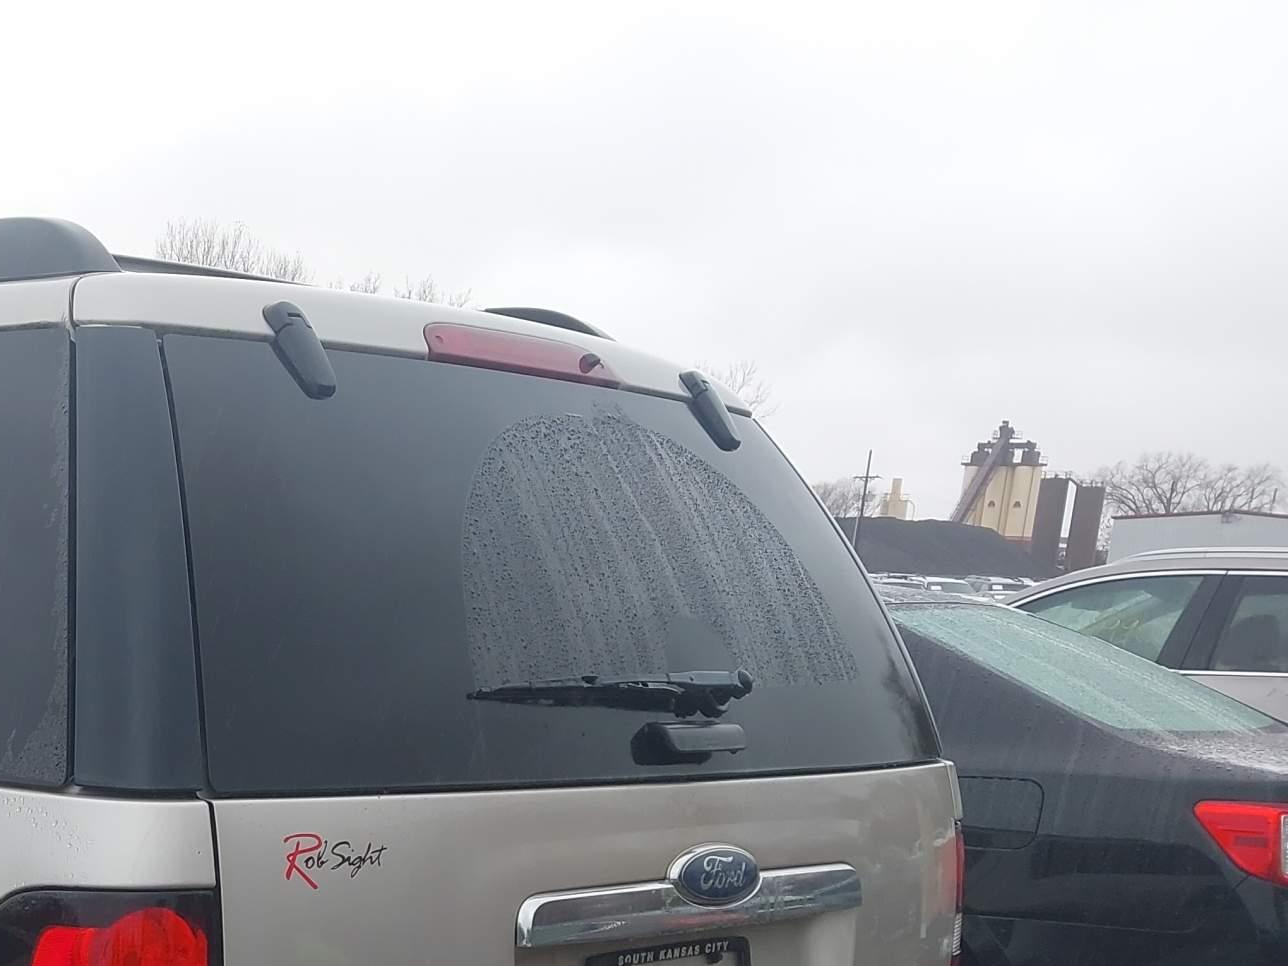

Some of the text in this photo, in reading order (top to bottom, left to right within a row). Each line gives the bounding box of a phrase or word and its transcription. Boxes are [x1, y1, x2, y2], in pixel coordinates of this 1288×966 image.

[283, 833, 388, 890] Rob Sight
[699, 855, 747, 890] Ford
[617, 941, 730, 966] SOUTH KANSAS CITY
